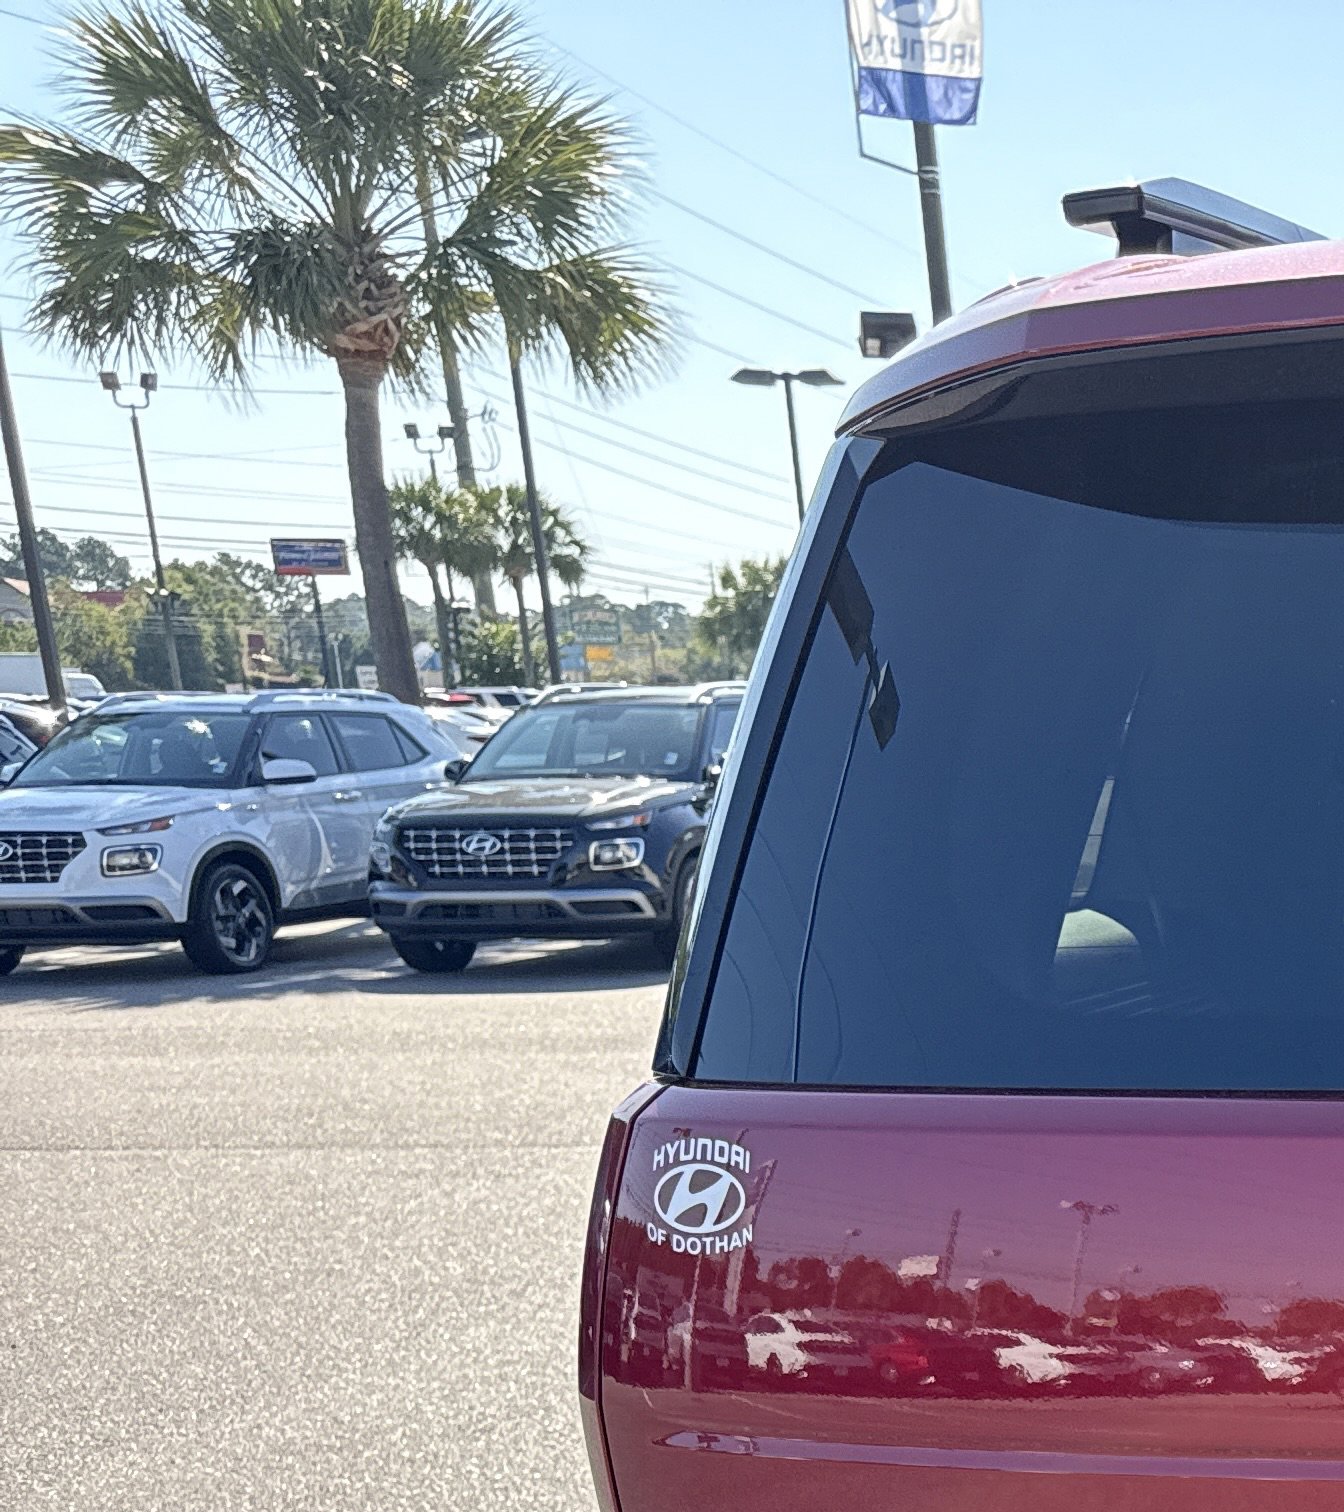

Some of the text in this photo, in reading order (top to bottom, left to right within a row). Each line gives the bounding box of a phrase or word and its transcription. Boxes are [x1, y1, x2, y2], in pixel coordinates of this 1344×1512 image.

[652, 1137, 751, 1174] HYUNDAI
[646, 1221, 753, 1256] OF DOTHAN
